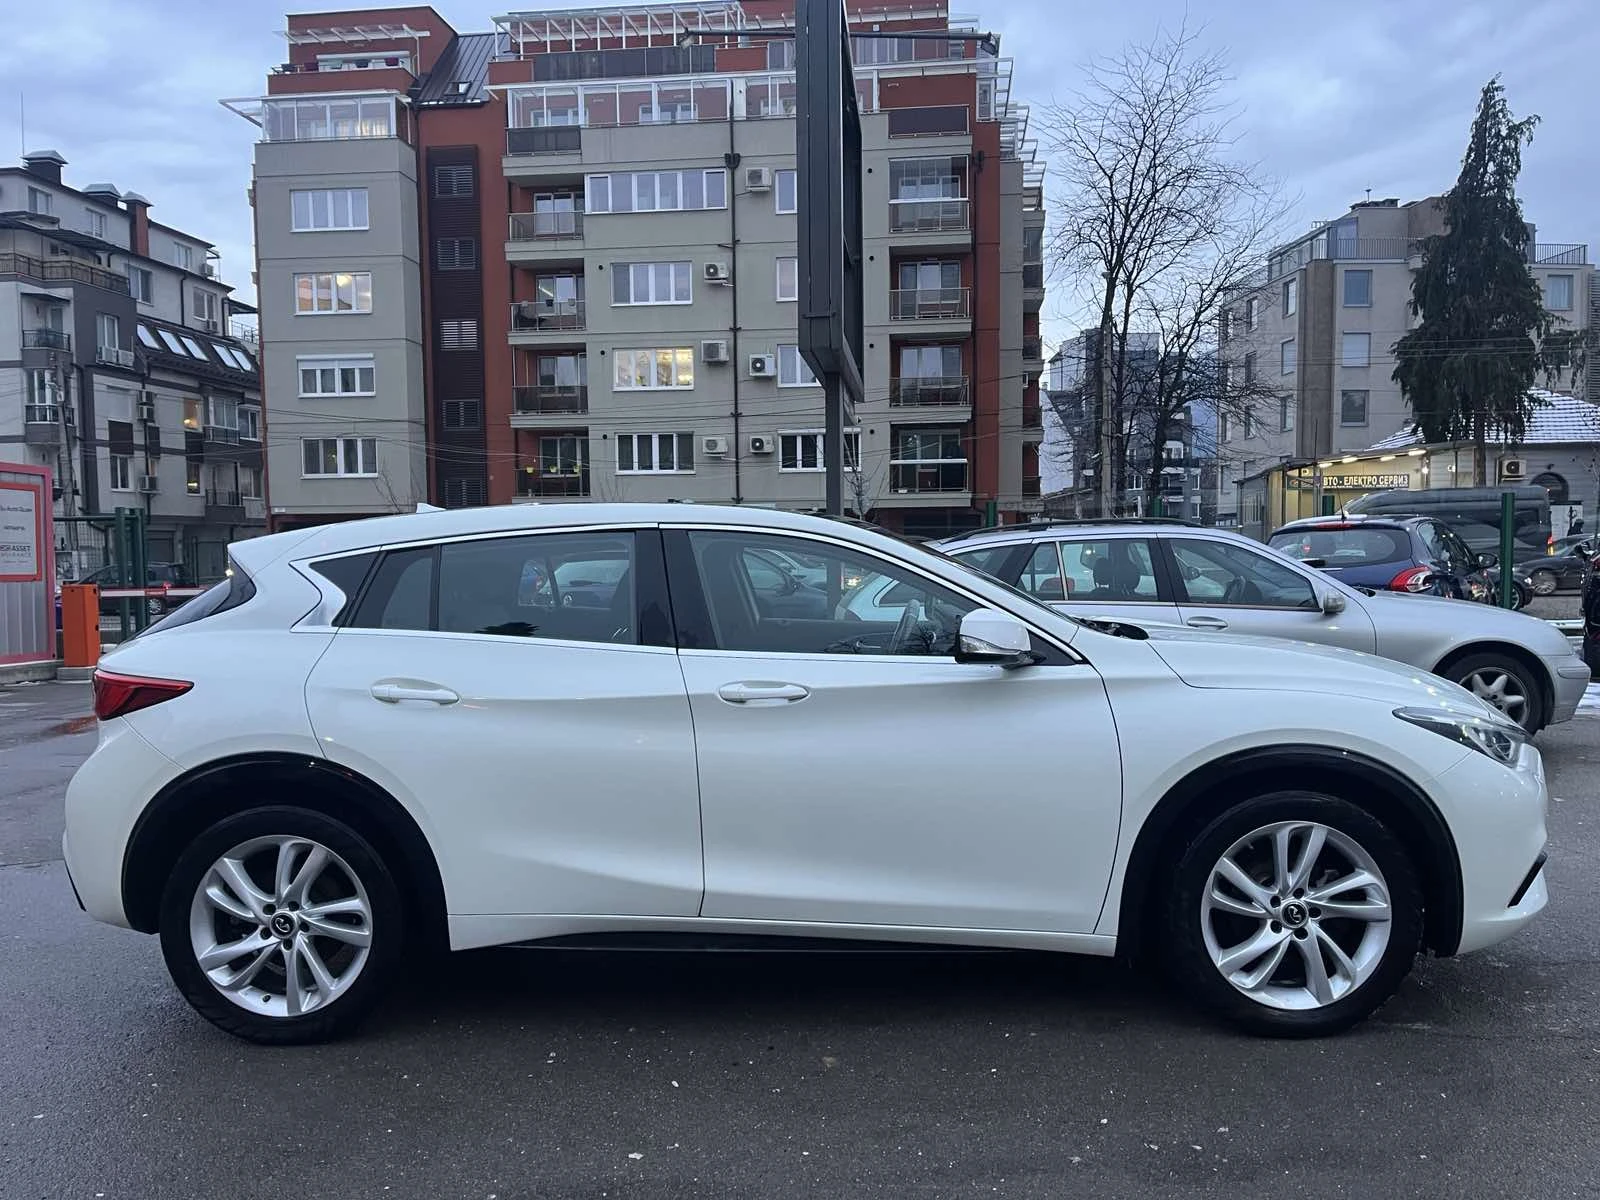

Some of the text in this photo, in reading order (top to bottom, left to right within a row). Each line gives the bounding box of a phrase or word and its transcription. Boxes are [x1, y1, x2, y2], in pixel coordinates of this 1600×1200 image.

[1322, 476, 1338, 485] ВТО
[1343, 476, 1377, 485] ЕЛЕКТРО
[1379, 475, 1408, 485] СЕРВИЗ
